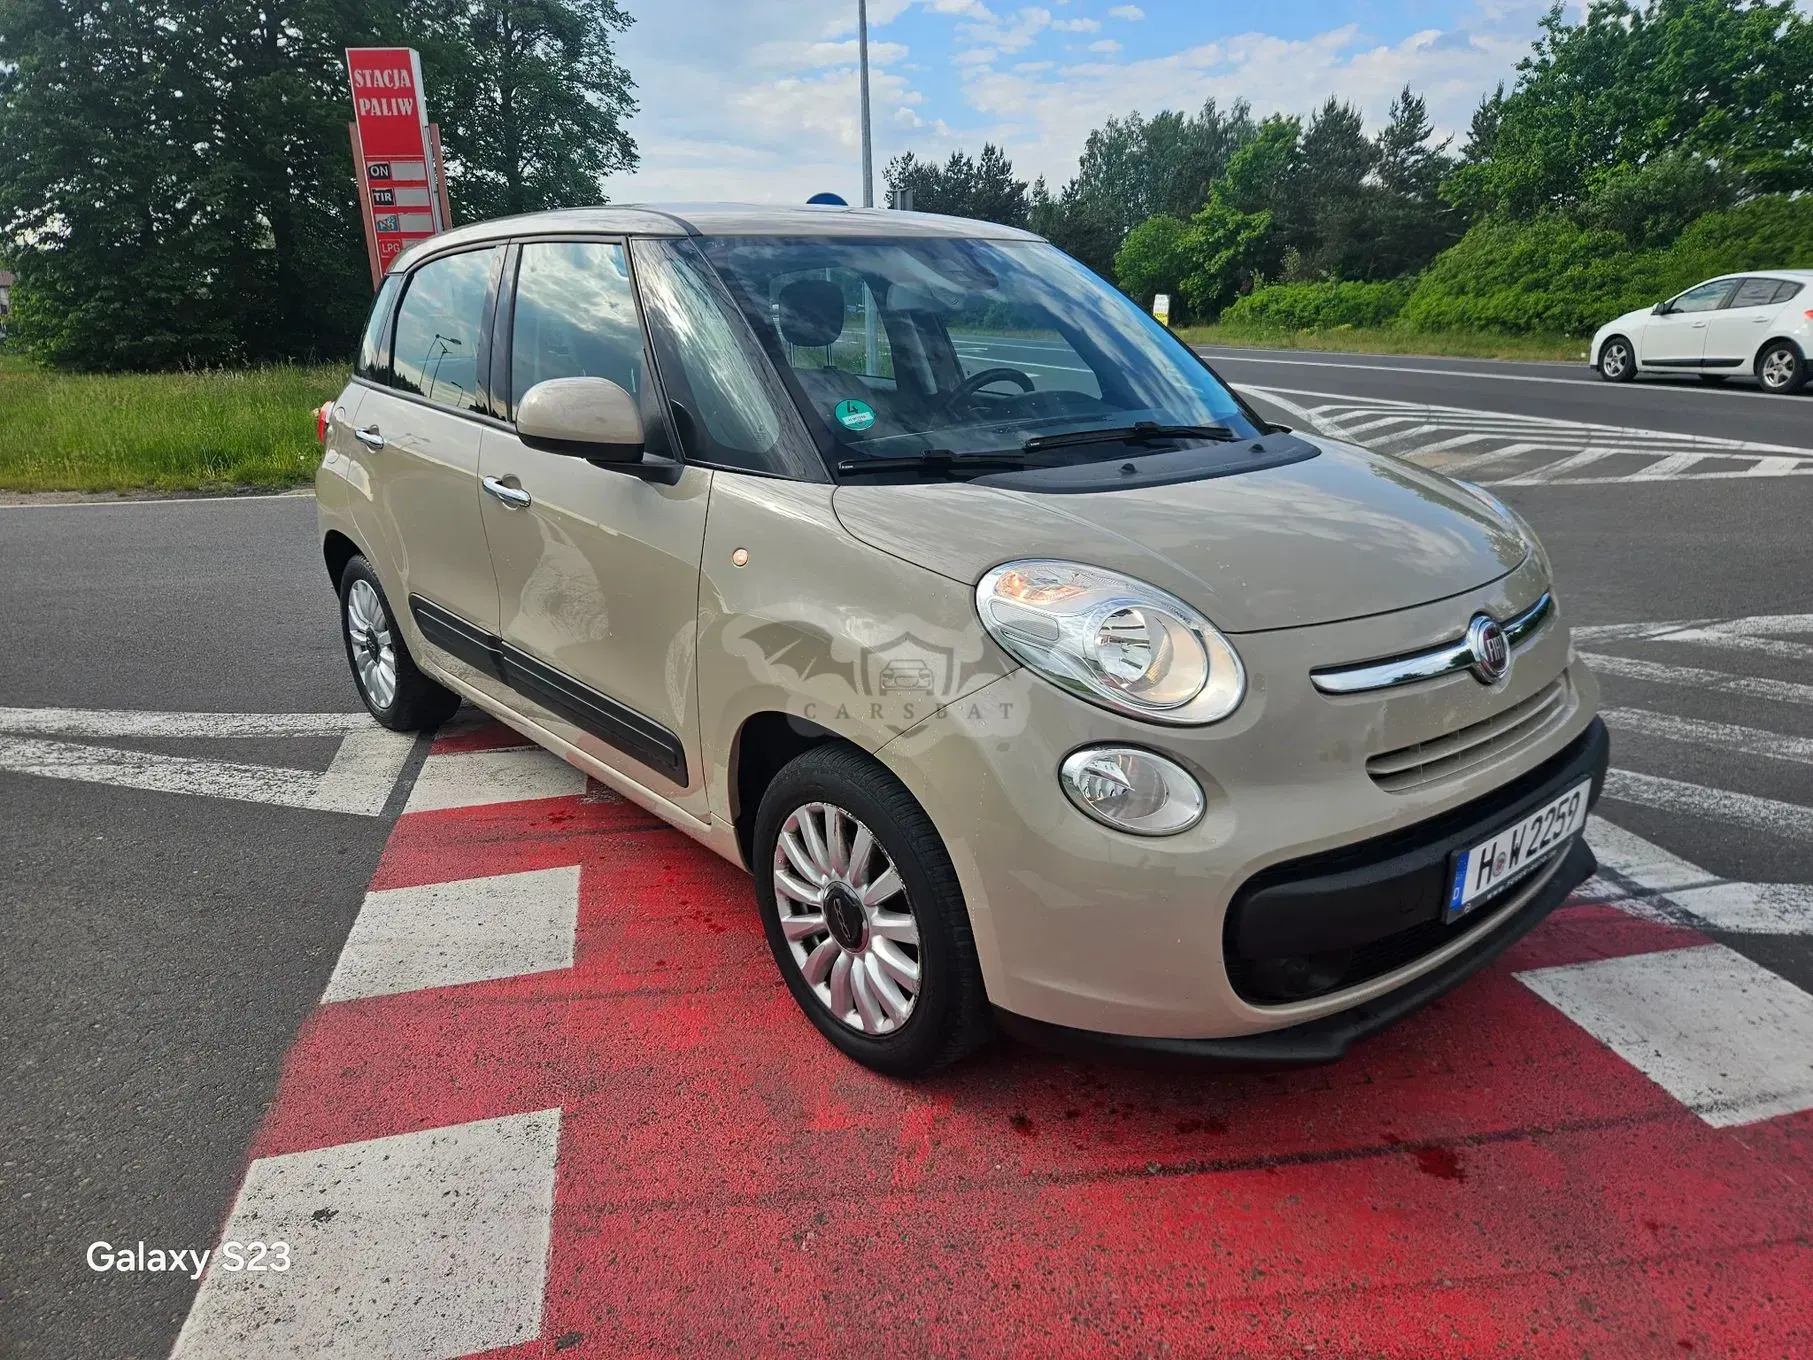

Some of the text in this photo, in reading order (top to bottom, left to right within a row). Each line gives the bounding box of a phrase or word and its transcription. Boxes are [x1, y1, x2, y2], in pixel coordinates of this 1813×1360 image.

[354, 69, 411, 89] STACJA
[359, 98, 413, 116] PALIW
[370, 166, 389, 177] ON
[374, 192, 392, 201] TIR
[382, 243, 400, 253] LPG
[846, 400, 859, 414] 4
